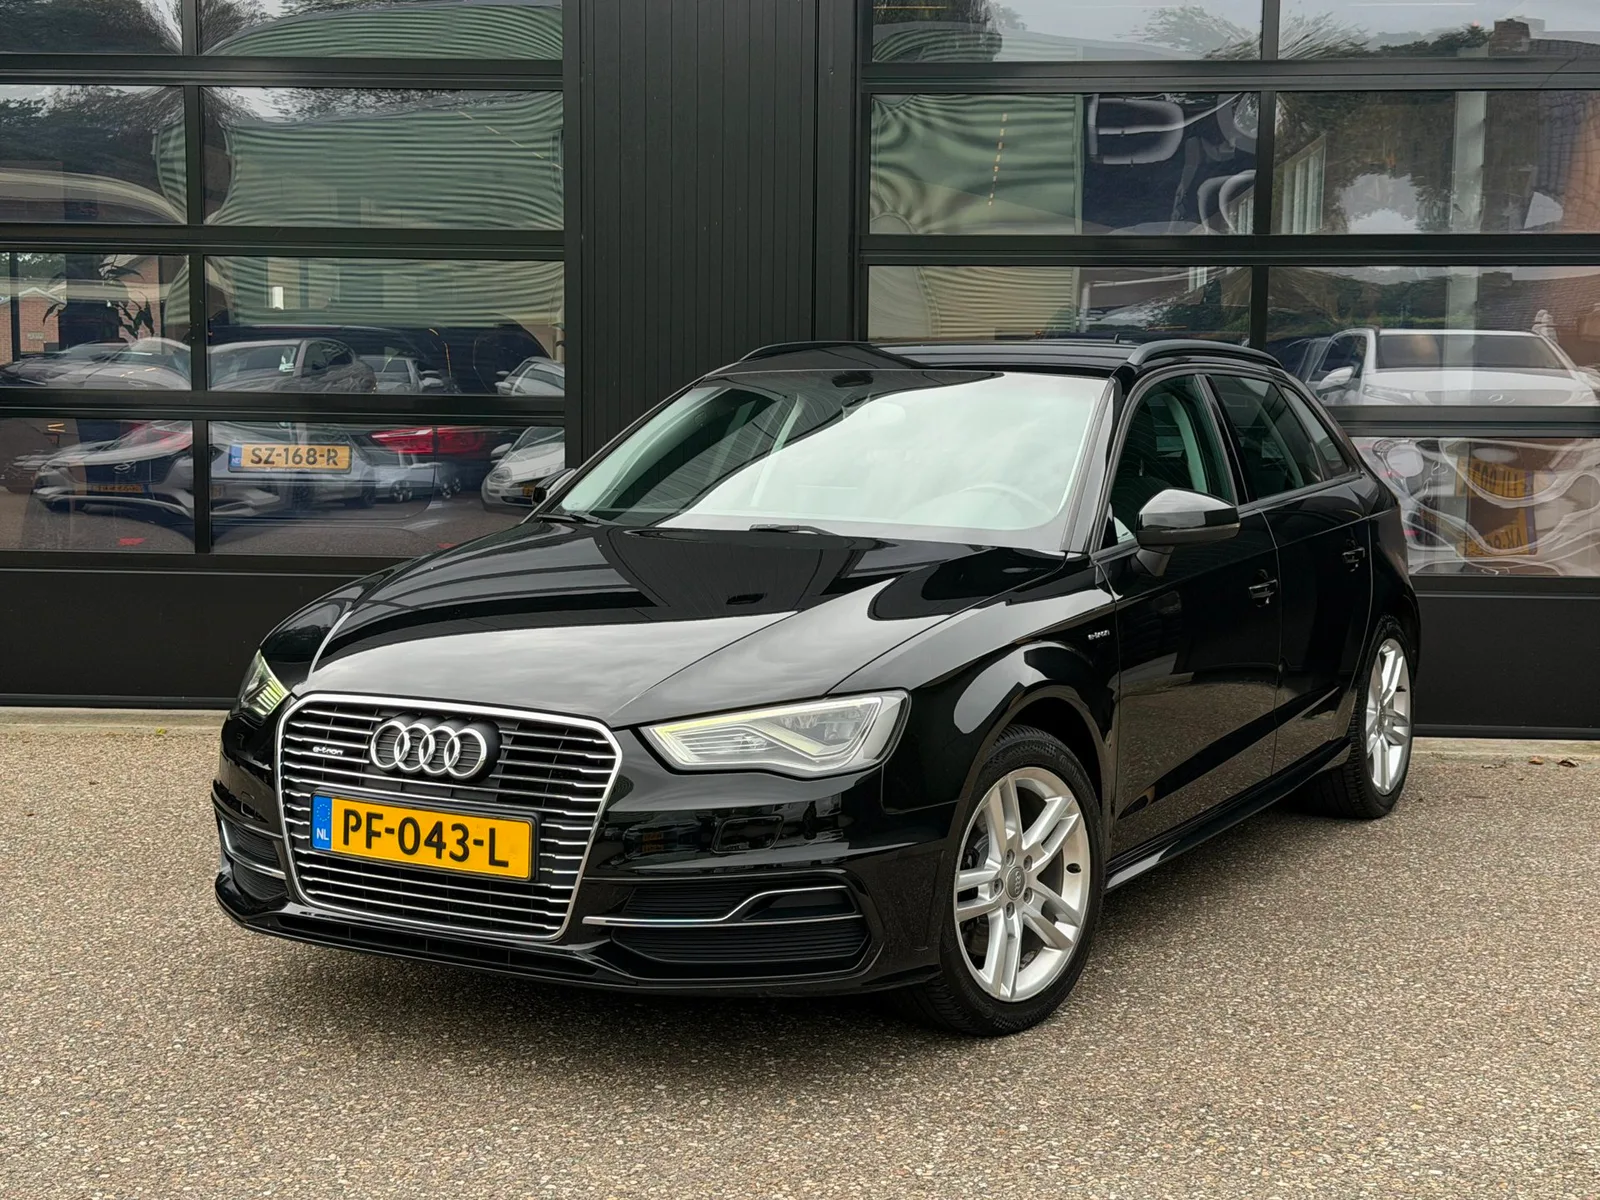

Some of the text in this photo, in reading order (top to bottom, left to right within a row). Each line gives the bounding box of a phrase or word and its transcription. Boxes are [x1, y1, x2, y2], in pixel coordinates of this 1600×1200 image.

[250, 447, 338, 466] SZ-168-R
[312, 746, 344, 755] e-tron
[316, 828, 330, 841] NL
[343, 808, 509, 868] PF-043-L
